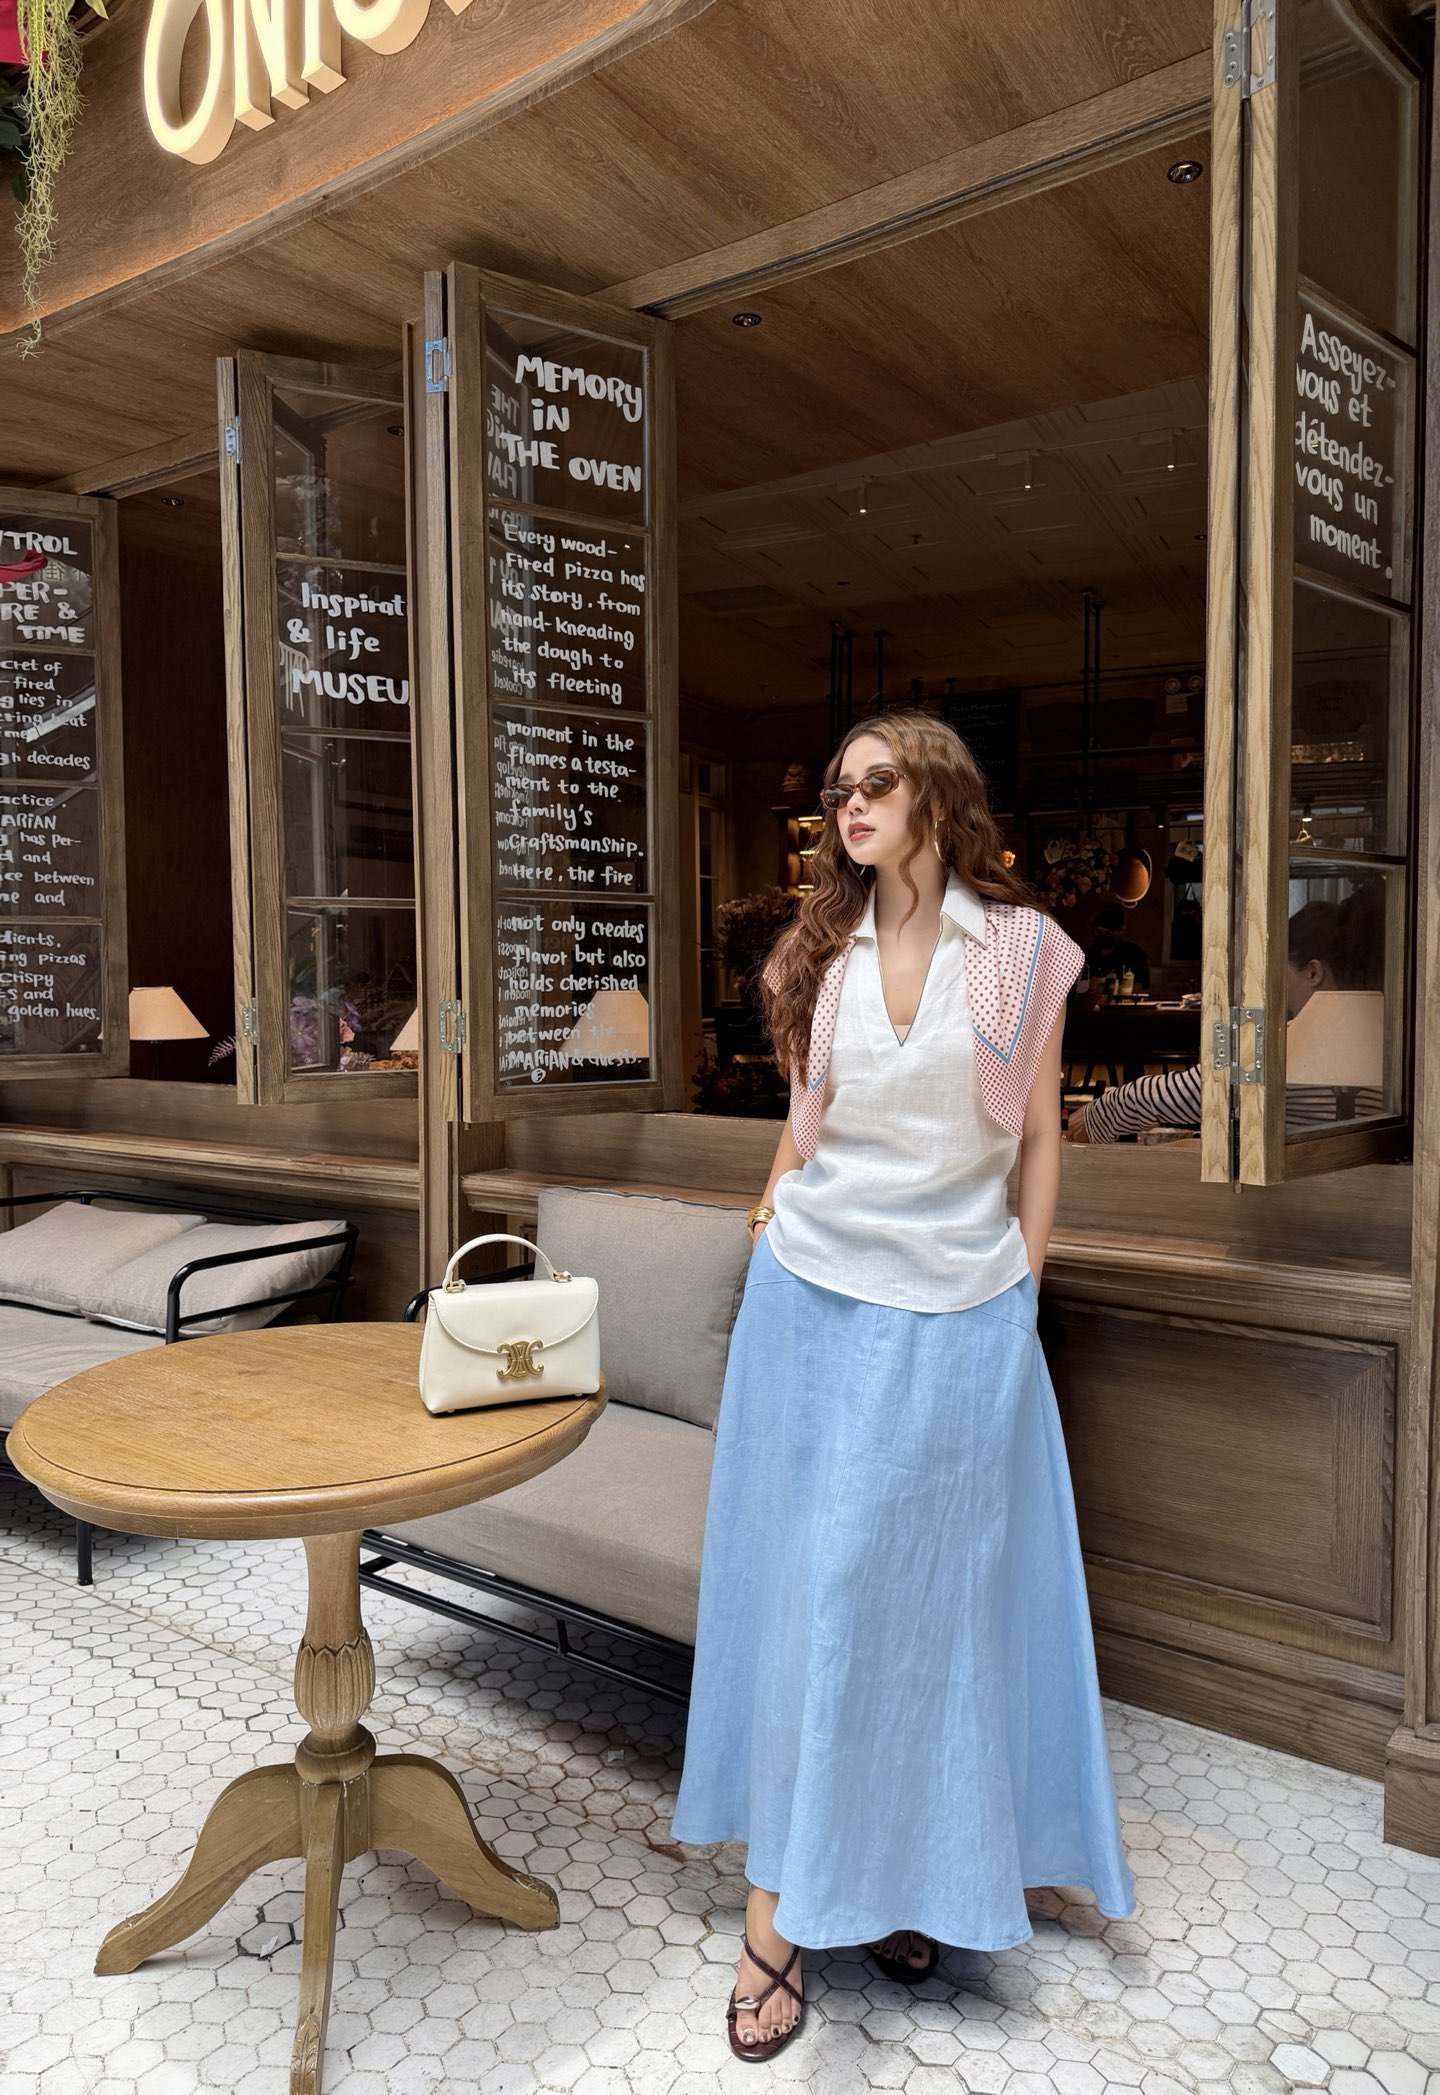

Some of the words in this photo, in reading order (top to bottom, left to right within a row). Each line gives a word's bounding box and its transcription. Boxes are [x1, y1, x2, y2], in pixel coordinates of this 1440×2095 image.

[1301, 313, 1396, 396] Asseyez-
[515, 354, 643, 423] MEMORY
[1296, 362, 1341, 416] vous
[1349, 393, 1373, 427] et
[499, 431, 560, 470] THE
[568, 456, 642, 493] OVEN
[1295, 411, 1394, 488] détendez-
[1295, 461, 1343, 512] vous
[1354, 492, 1378, 526] un
[503, 523, 556, 554] Every
[561, 540, 618, 557] wood-
[1310, 514, 1393, 580] moment.
[506, 552, 554, 578] Fired
[565, 561, 613, 583] pizza
[620, 569, 646, 592] has
[57, 601, 79, 620] &
[301, 582, 405, 618] Inspirat
[501, 578, 525, 600] its
[597, 592, 641, 616] from
[286, 618, 313, 643] &
[326, 625, 381, 661] life
[502, 637, 531, 655] the
[537, 641, 593, 671] dough
[600, 653, 625, 669] to
[43, 661, 63, 677] of
[292, 667, 410, 705] MUSEU
[512, 665, 537, 689] its
[547, 672, 623, 705] fleeting
[19, 693, 46, 708] lies
[56, 694, 73, 708] in
[506, 721, 574, 744] moment
[582, 730, 598, 748] in
[605, 733, 635, 752] the
[27, 751, 91, 770] decades
[507, 746, 567, 770] flames
[571, 757, 582, 771] a
[585, 756, 637, 778] testa-
[506, 775, 550, 792] ment
[557, 779, 580, 794] to
[587, 781, 619, 798] the
[510, 798, 593, 831] family's
[20, 832, 46, 847] has
[22, 851, 52, 865] and
[34, 870, 95, 886] between
[567, 866, 595, 883] the
[600, 866, 634, 886] fire
[34, 889, 66, 907] and
[511, 914, 545, 932] not
[552, 915, 585, 941] only
[591, 920, 645, 944] creates
[38, 953, 87, 966] pizzas
[512, 945, 568, 967] flavor
[575, 943, 606, 965] but
[613, 950, 646, 968] also
[24, 987, 54, 1002] and
[509, 973, 555, 992] holds
[560, 974, 639, 992] cherished
[8, 1003, 59, 1022] golden
[66, 1002, 100, 1020] hues.
[515, 1000, 596, 1019] memories
[508, 1027, 580, 1045] between
[571, 1047, 584, 1068] &
